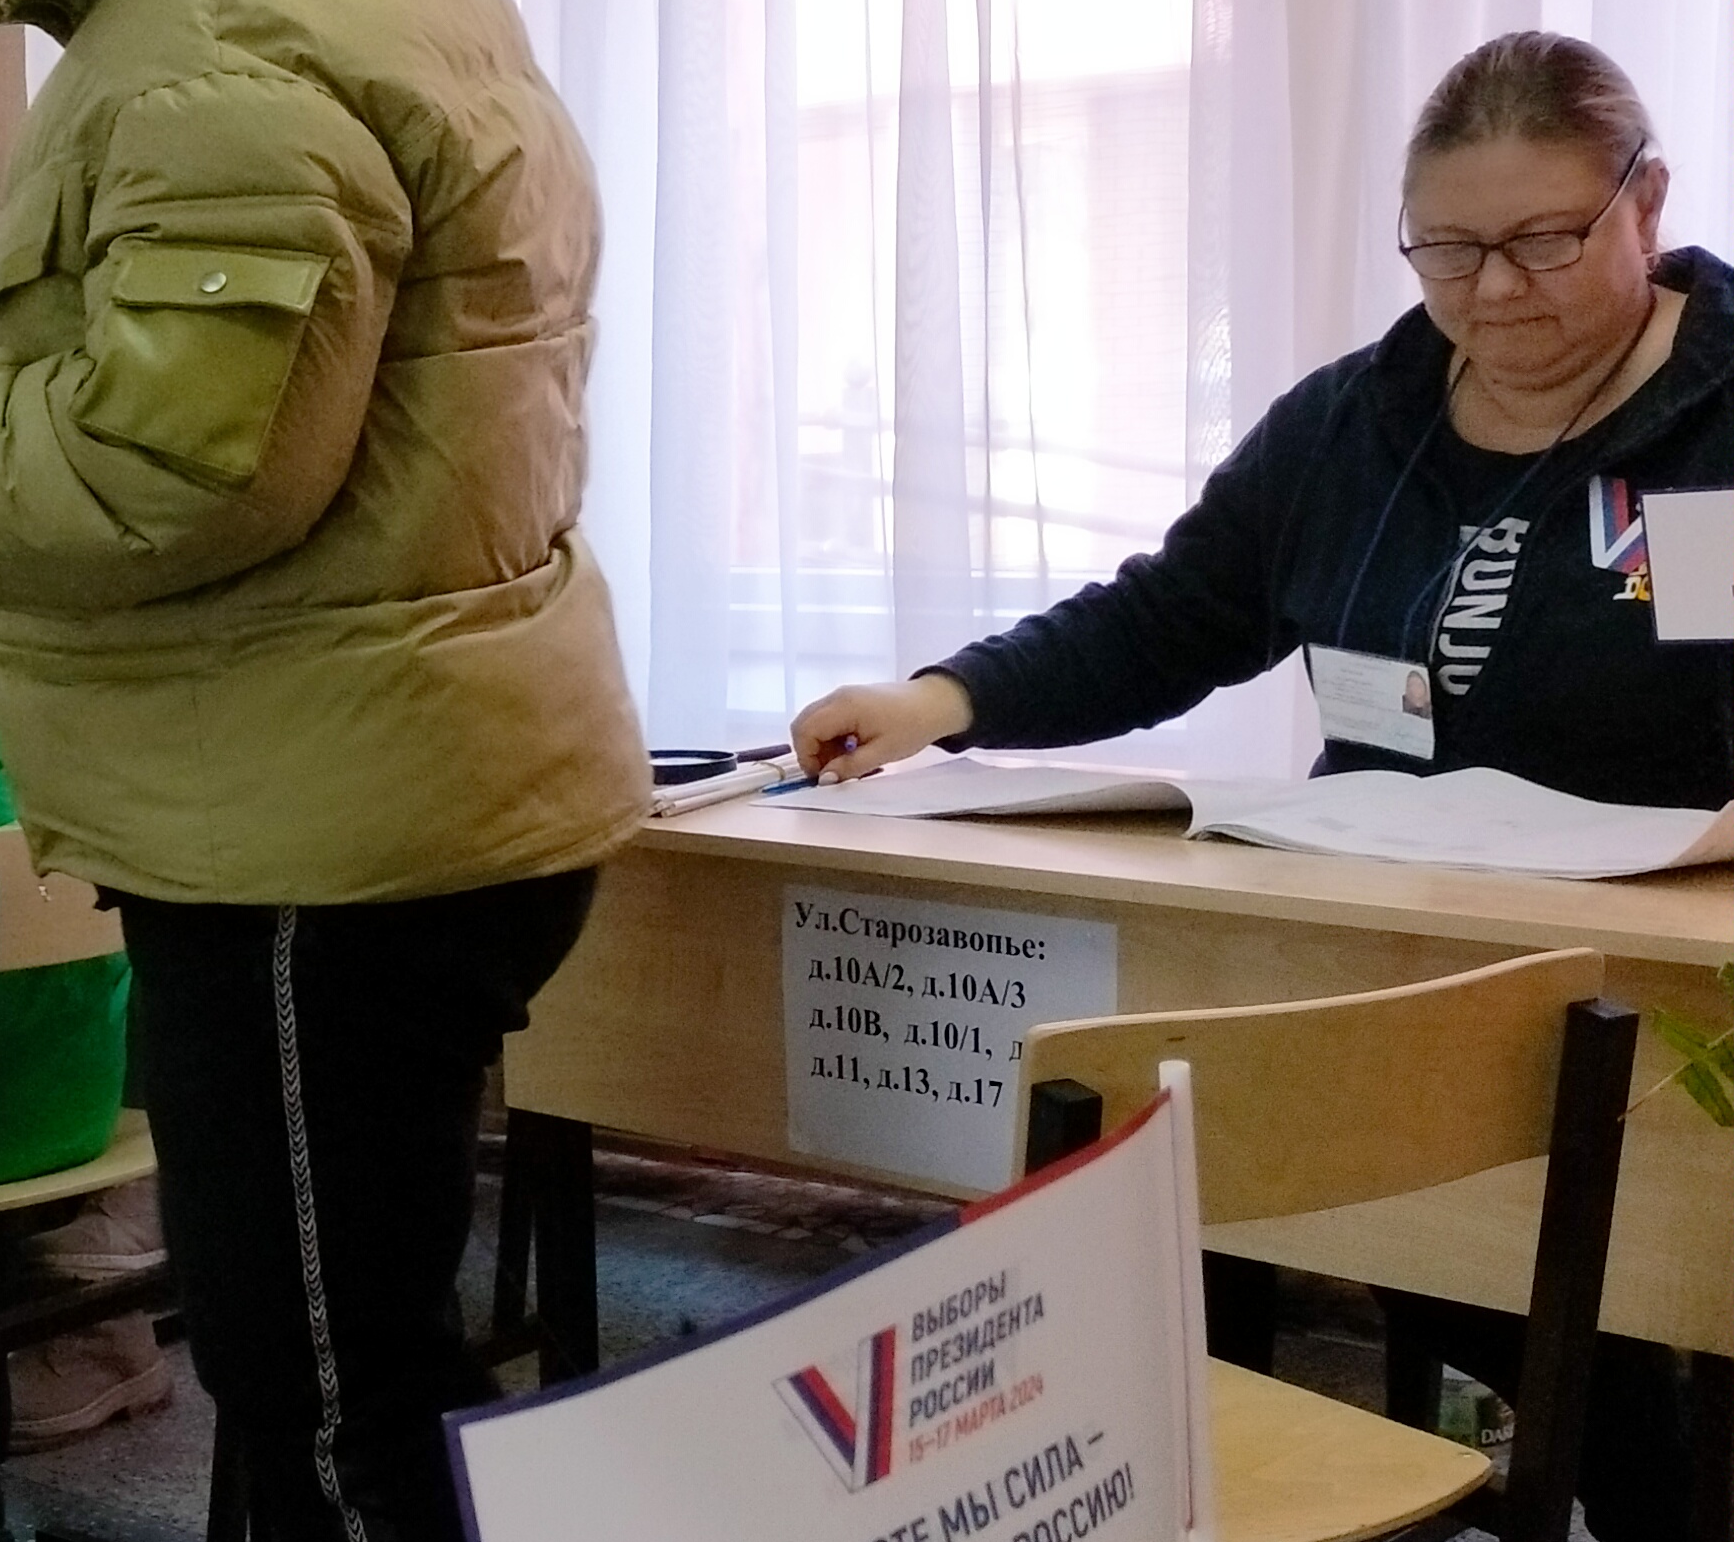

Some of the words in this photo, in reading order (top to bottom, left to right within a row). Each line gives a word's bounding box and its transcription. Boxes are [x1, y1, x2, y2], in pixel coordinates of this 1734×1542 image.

[808, 956, 914, 997] д.10А/2,
[921, 973, 1027, 1009] д.10А/3
[808, 1005, 890, 1044] д.10В,
[904, 1021, 992, 1060] д.10/1,
[811, 1054, 870, 1090] д.11,
[876, 1066, 939, 1101] д.13,
[946, 1080, 1004, 1108] д.17
[910, 1292, 1044, 1385] ПРЕЗИДЕНТА
[911, 1270, 1007, 1344] ВЫБОРЫ
[909, 1358, 995, 1428] РОССИИ
[954, 1392, 1006, 1441] МАРТА
[1006, 1373, 1044, 1411] 2024
[1004, 1435, 1084, 1509] СИЛА
